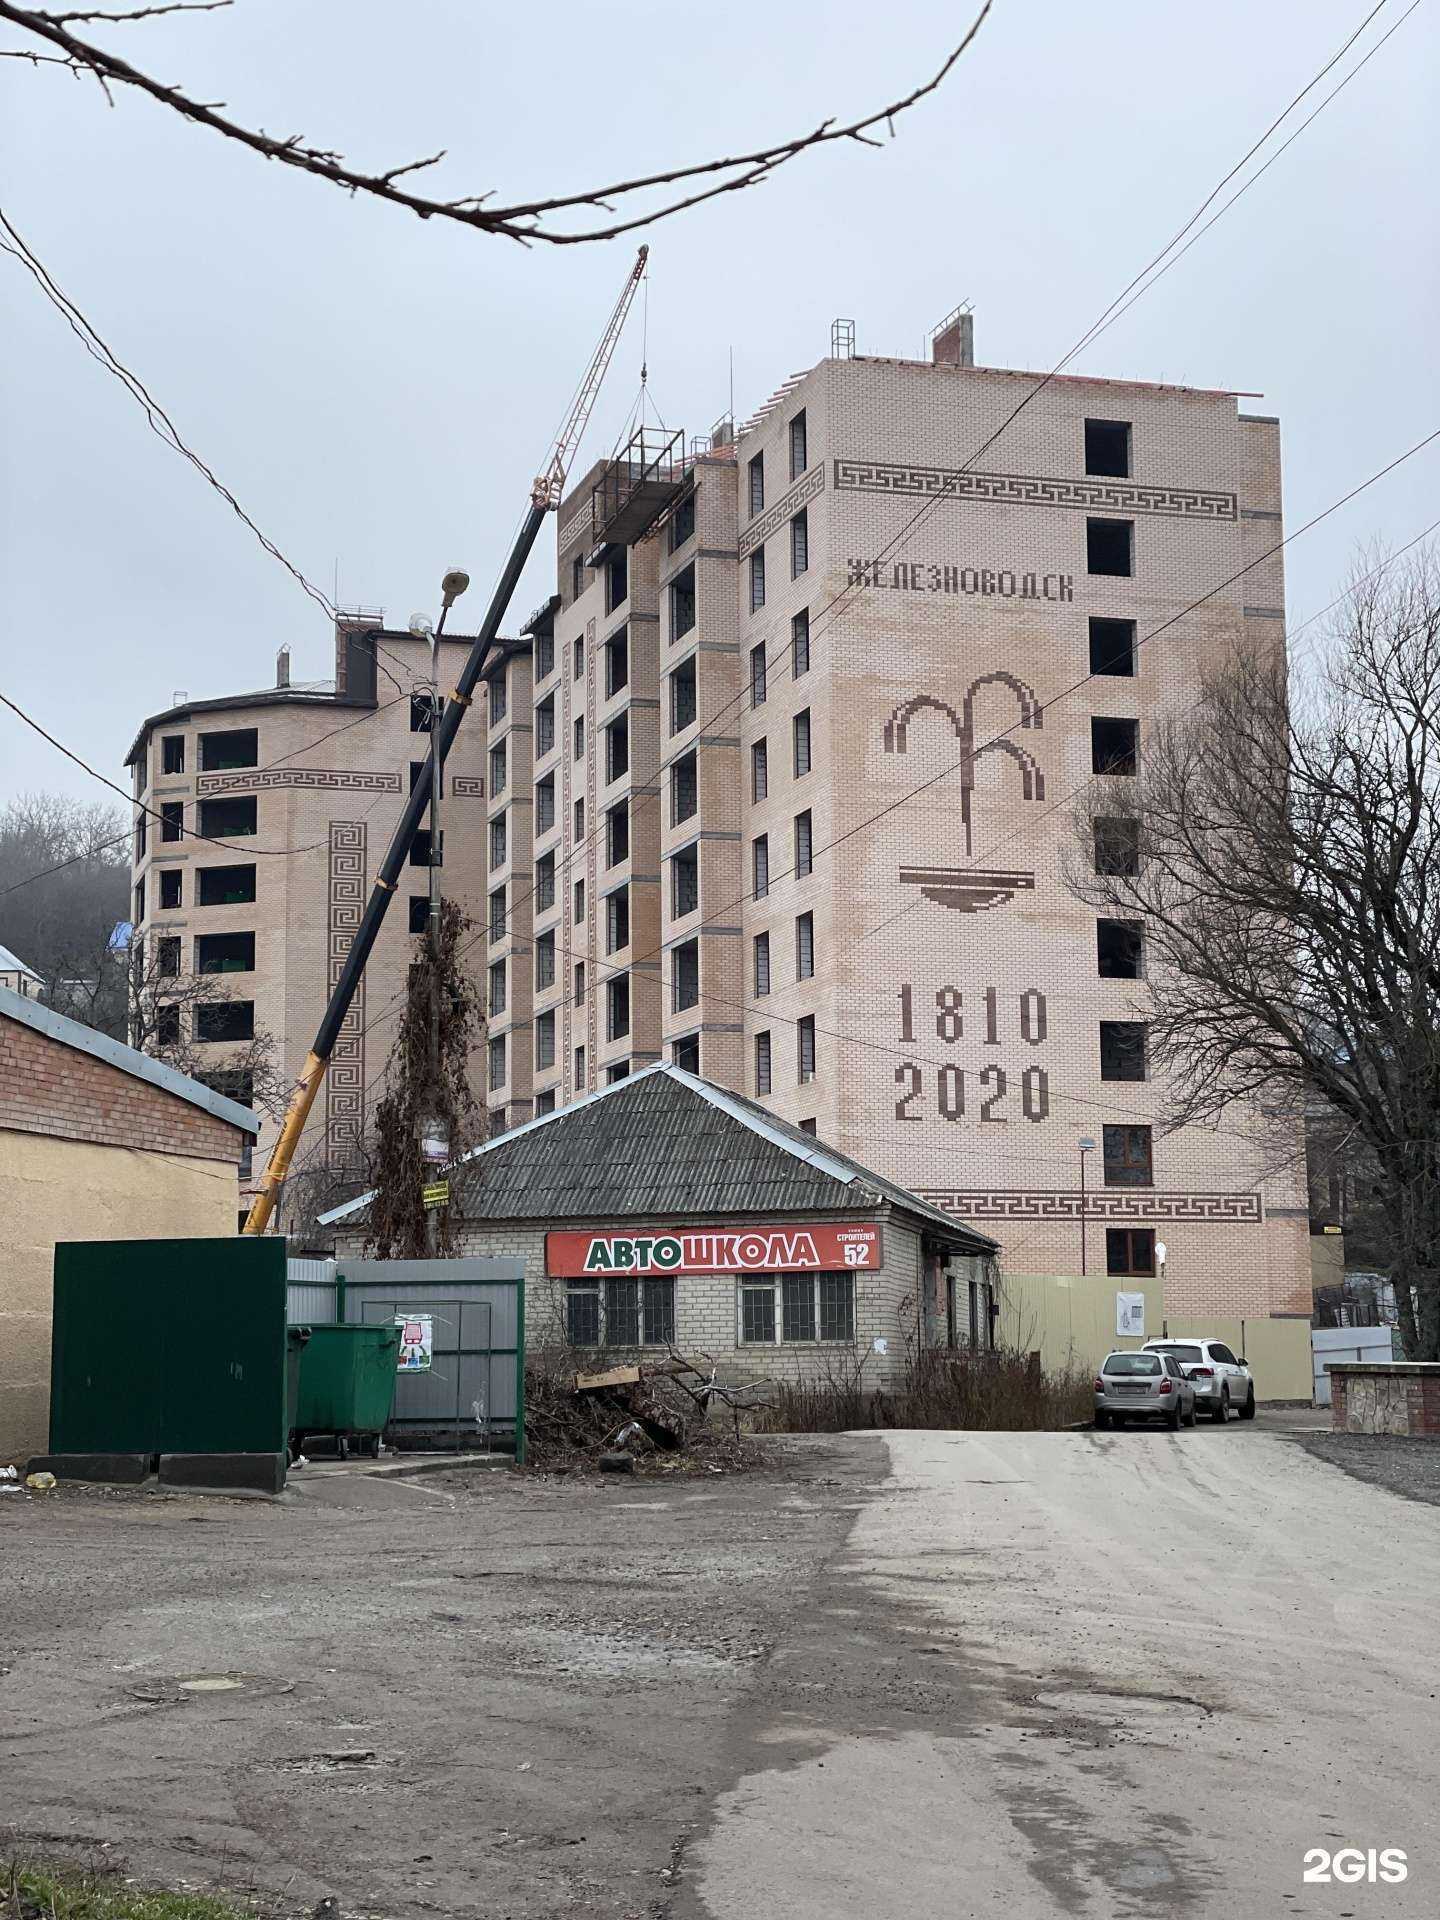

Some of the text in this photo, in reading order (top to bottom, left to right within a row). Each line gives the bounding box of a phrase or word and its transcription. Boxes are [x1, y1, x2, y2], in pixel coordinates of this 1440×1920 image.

[848, 559, 1073, 602] ЖЕЛЕЗНОВОДСК
[898, 984, 1047, 1046] 1810
[895, 1062, 1049, 1123] 2020
[583, 1233, 820, 1272] АВТОШКОЛА
[844, 1244, 869, 1265] 52
